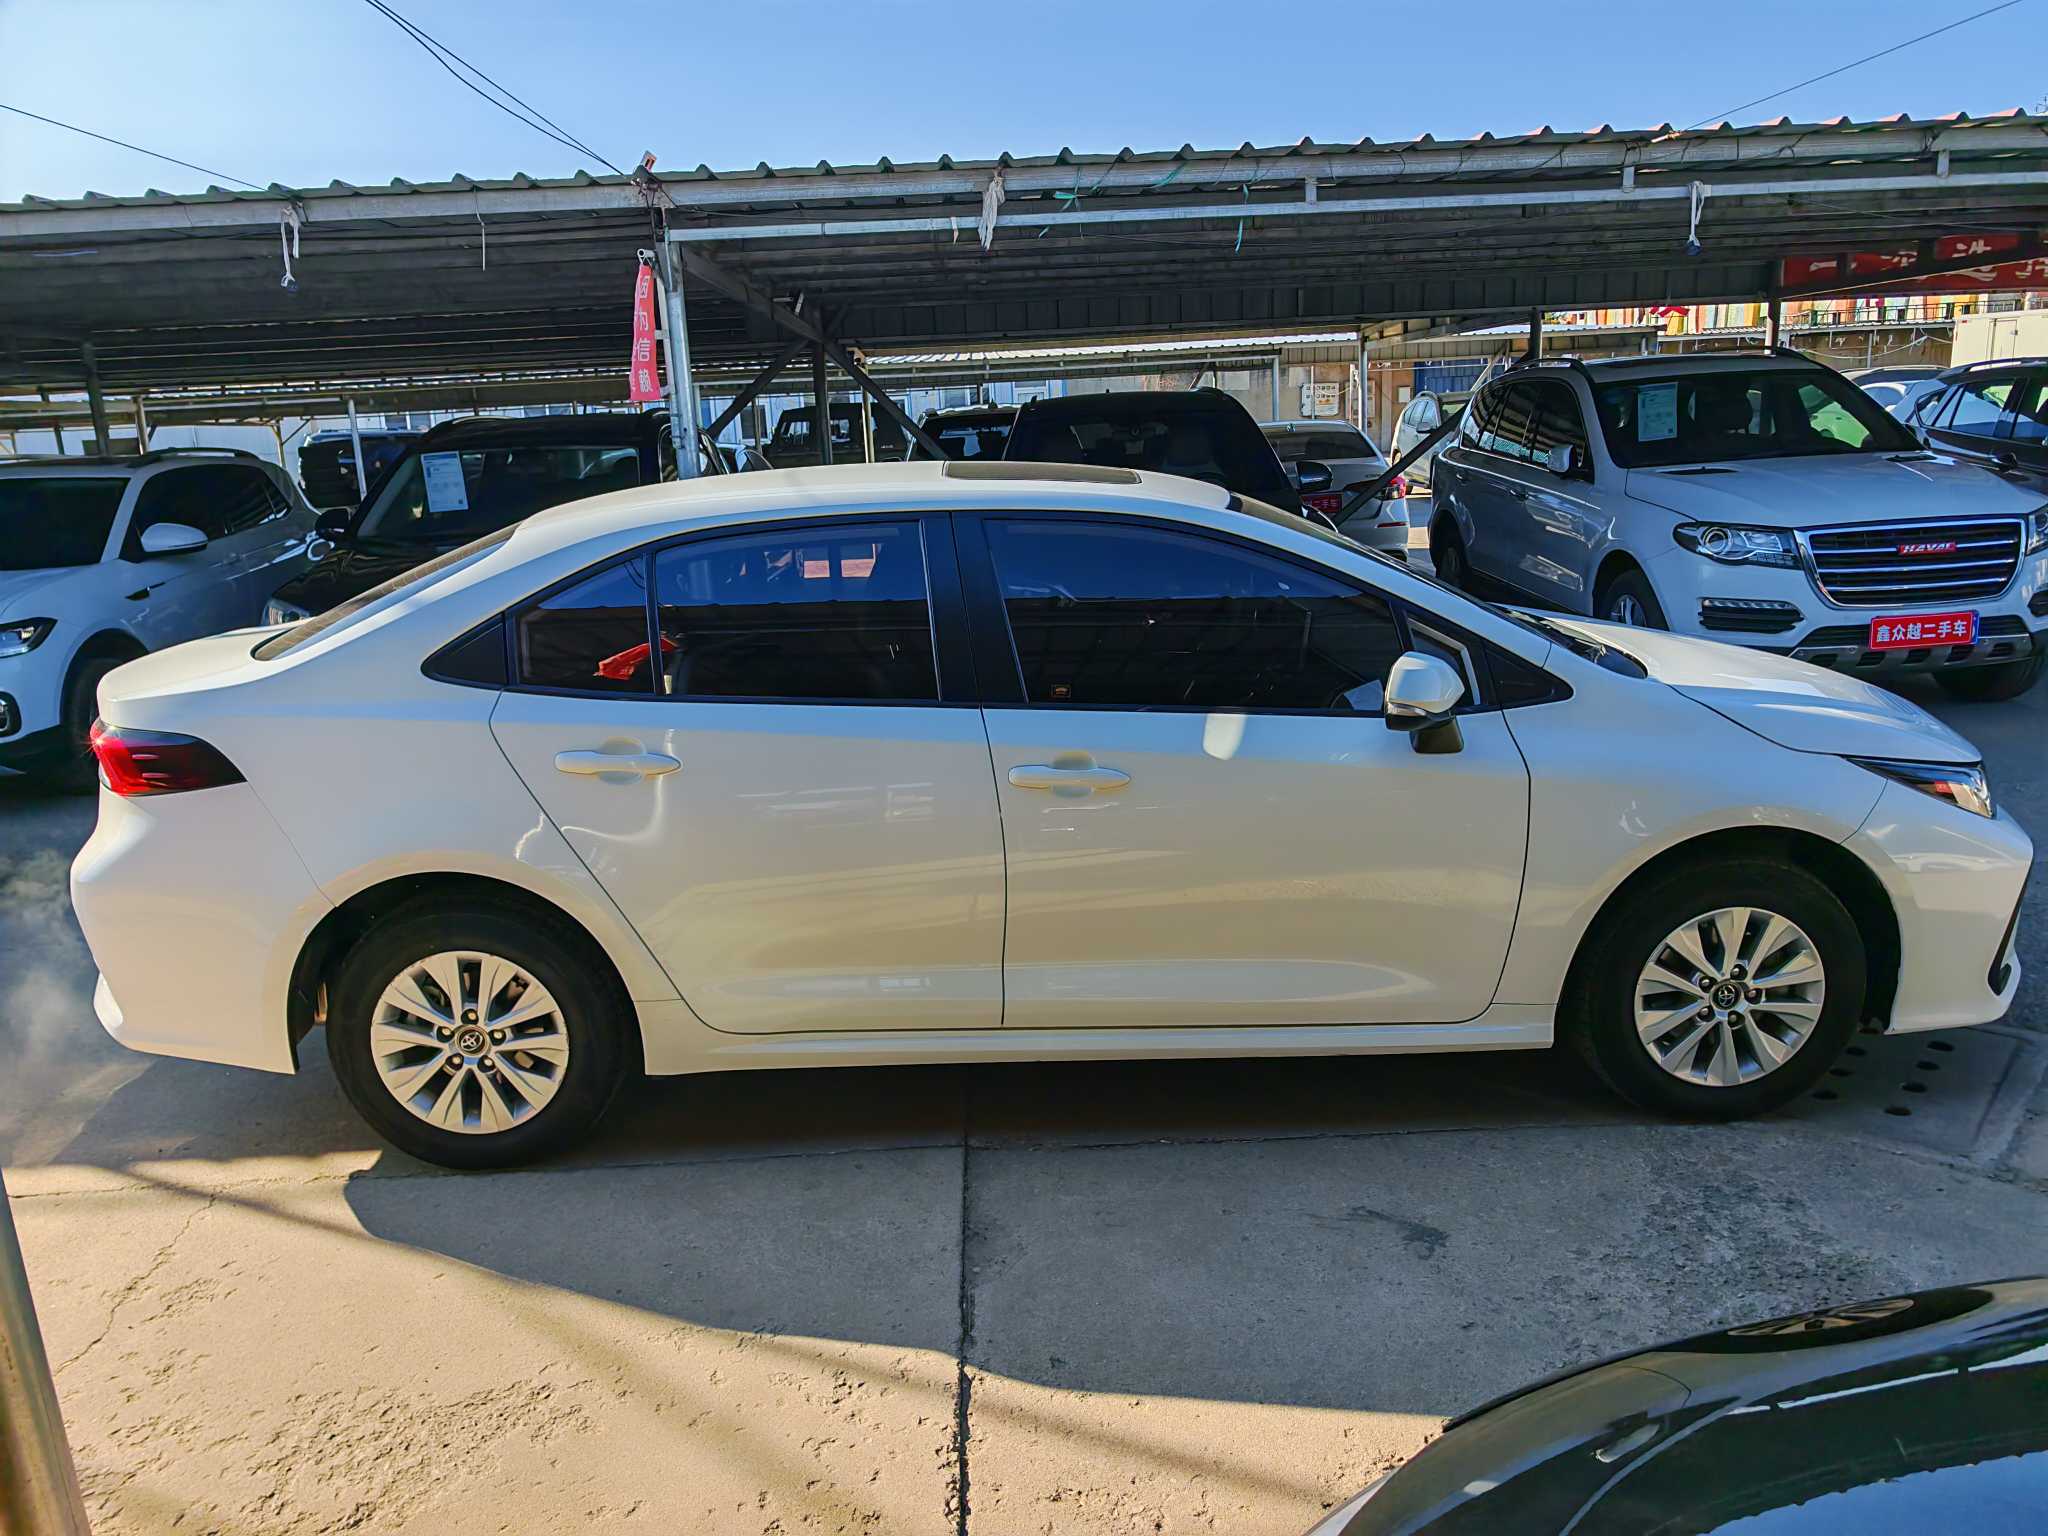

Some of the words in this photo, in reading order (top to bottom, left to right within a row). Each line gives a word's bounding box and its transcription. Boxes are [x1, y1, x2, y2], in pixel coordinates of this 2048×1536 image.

[1877, 620, 1967, 642] 鑫众越二手车
